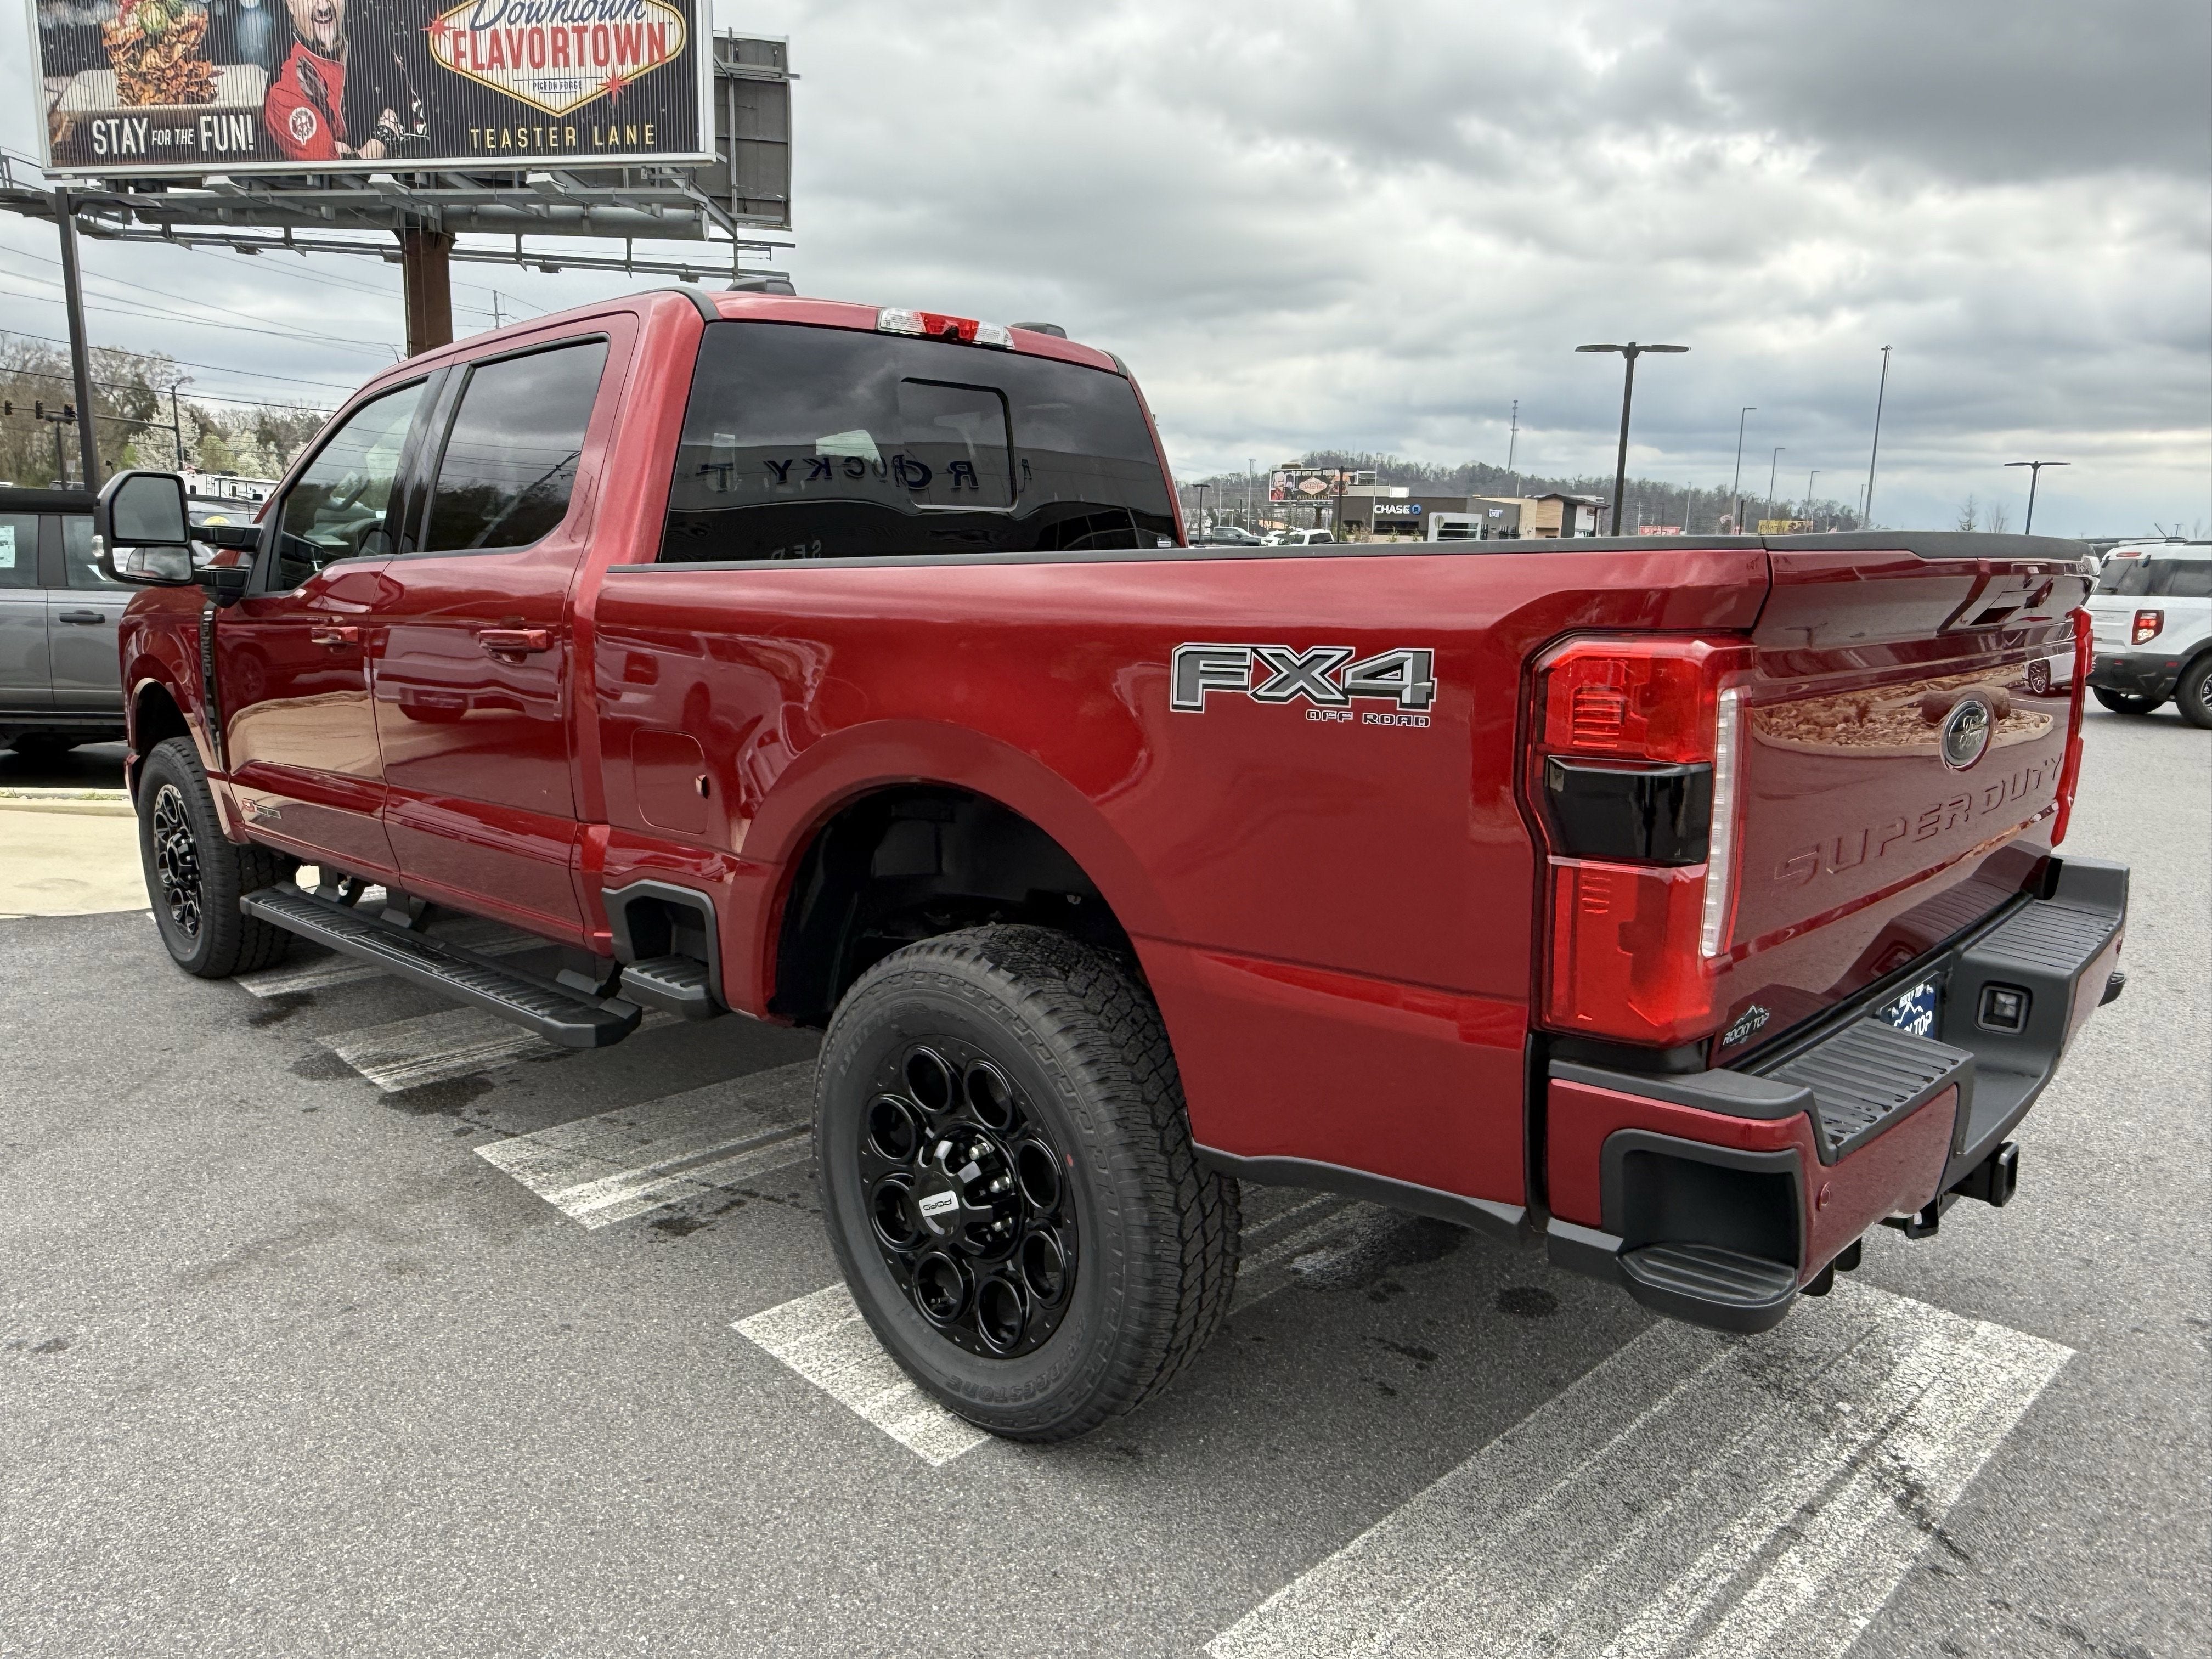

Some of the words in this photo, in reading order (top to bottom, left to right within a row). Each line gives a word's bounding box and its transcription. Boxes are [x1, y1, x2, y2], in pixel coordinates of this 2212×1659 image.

[452, 22, 667, 71] FLAVORTOWN
[92, 117, 148, 155] STAY
[151, 129, 171, 146] FOR
[174, 128, 194, 145] THE
[199, 114, 254, 152] FUN!
[470, 126, 576, 149] TEASTER
[594, 124, 655, 146] LANE
[1374, 504, 1410, 515] CHASE
[1170, 642, 1437, 713] FX4
[1306, 709, 1353, 723] OFF
[1362, 713, 1431, 728] ROAD
[1774, 792, 1972, 885] SUPER
[1979, 752, 2063, 815] DUTY
[1914, 1010, 1933, 1036] TOP
